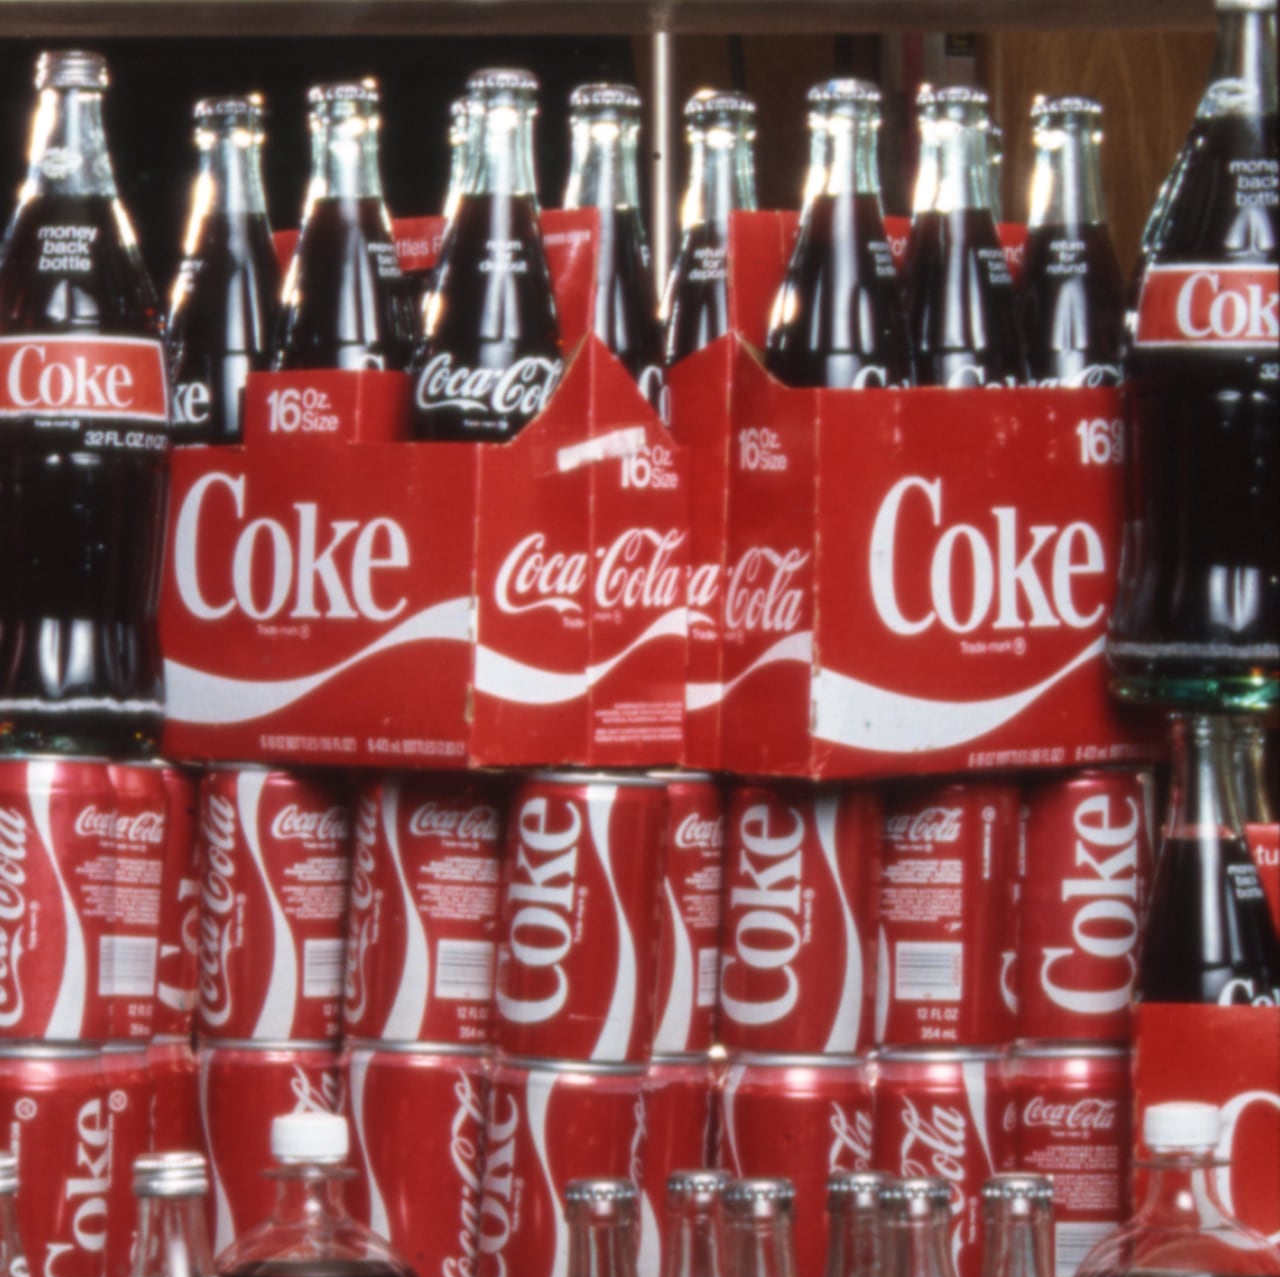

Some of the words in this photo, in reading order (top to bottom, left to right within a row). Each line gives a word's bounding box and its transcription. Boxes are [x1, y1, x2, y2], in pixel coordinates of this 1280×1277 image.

[1228, 159, 1279, 174] mone
[38, 226, 97, 244] money
[42, 240, 89, 255] back
[38, 254, 92, 272] bottle
[1176, 270, 1280, 338] Cok
[7, 344, 133, 409] Coke
[268, 388, 302, 433] 16
[302, 388, 332, 410] Oz.
[302, 411, 339, 432] Size
[740, 429, 760, 470] 16
[760, 452, 788, 470] Size
[1076, 418, 1112, 465] 16
[651, 468, 679, 490] Size
[174, 472, 410, 621] Coke
[869, 475, 1106, 636] Coke
[496, 797, 582, 1025] Coke
[720, 803, 805, 1025] Coke
[1041, 794, 1139, 1014] Coke
